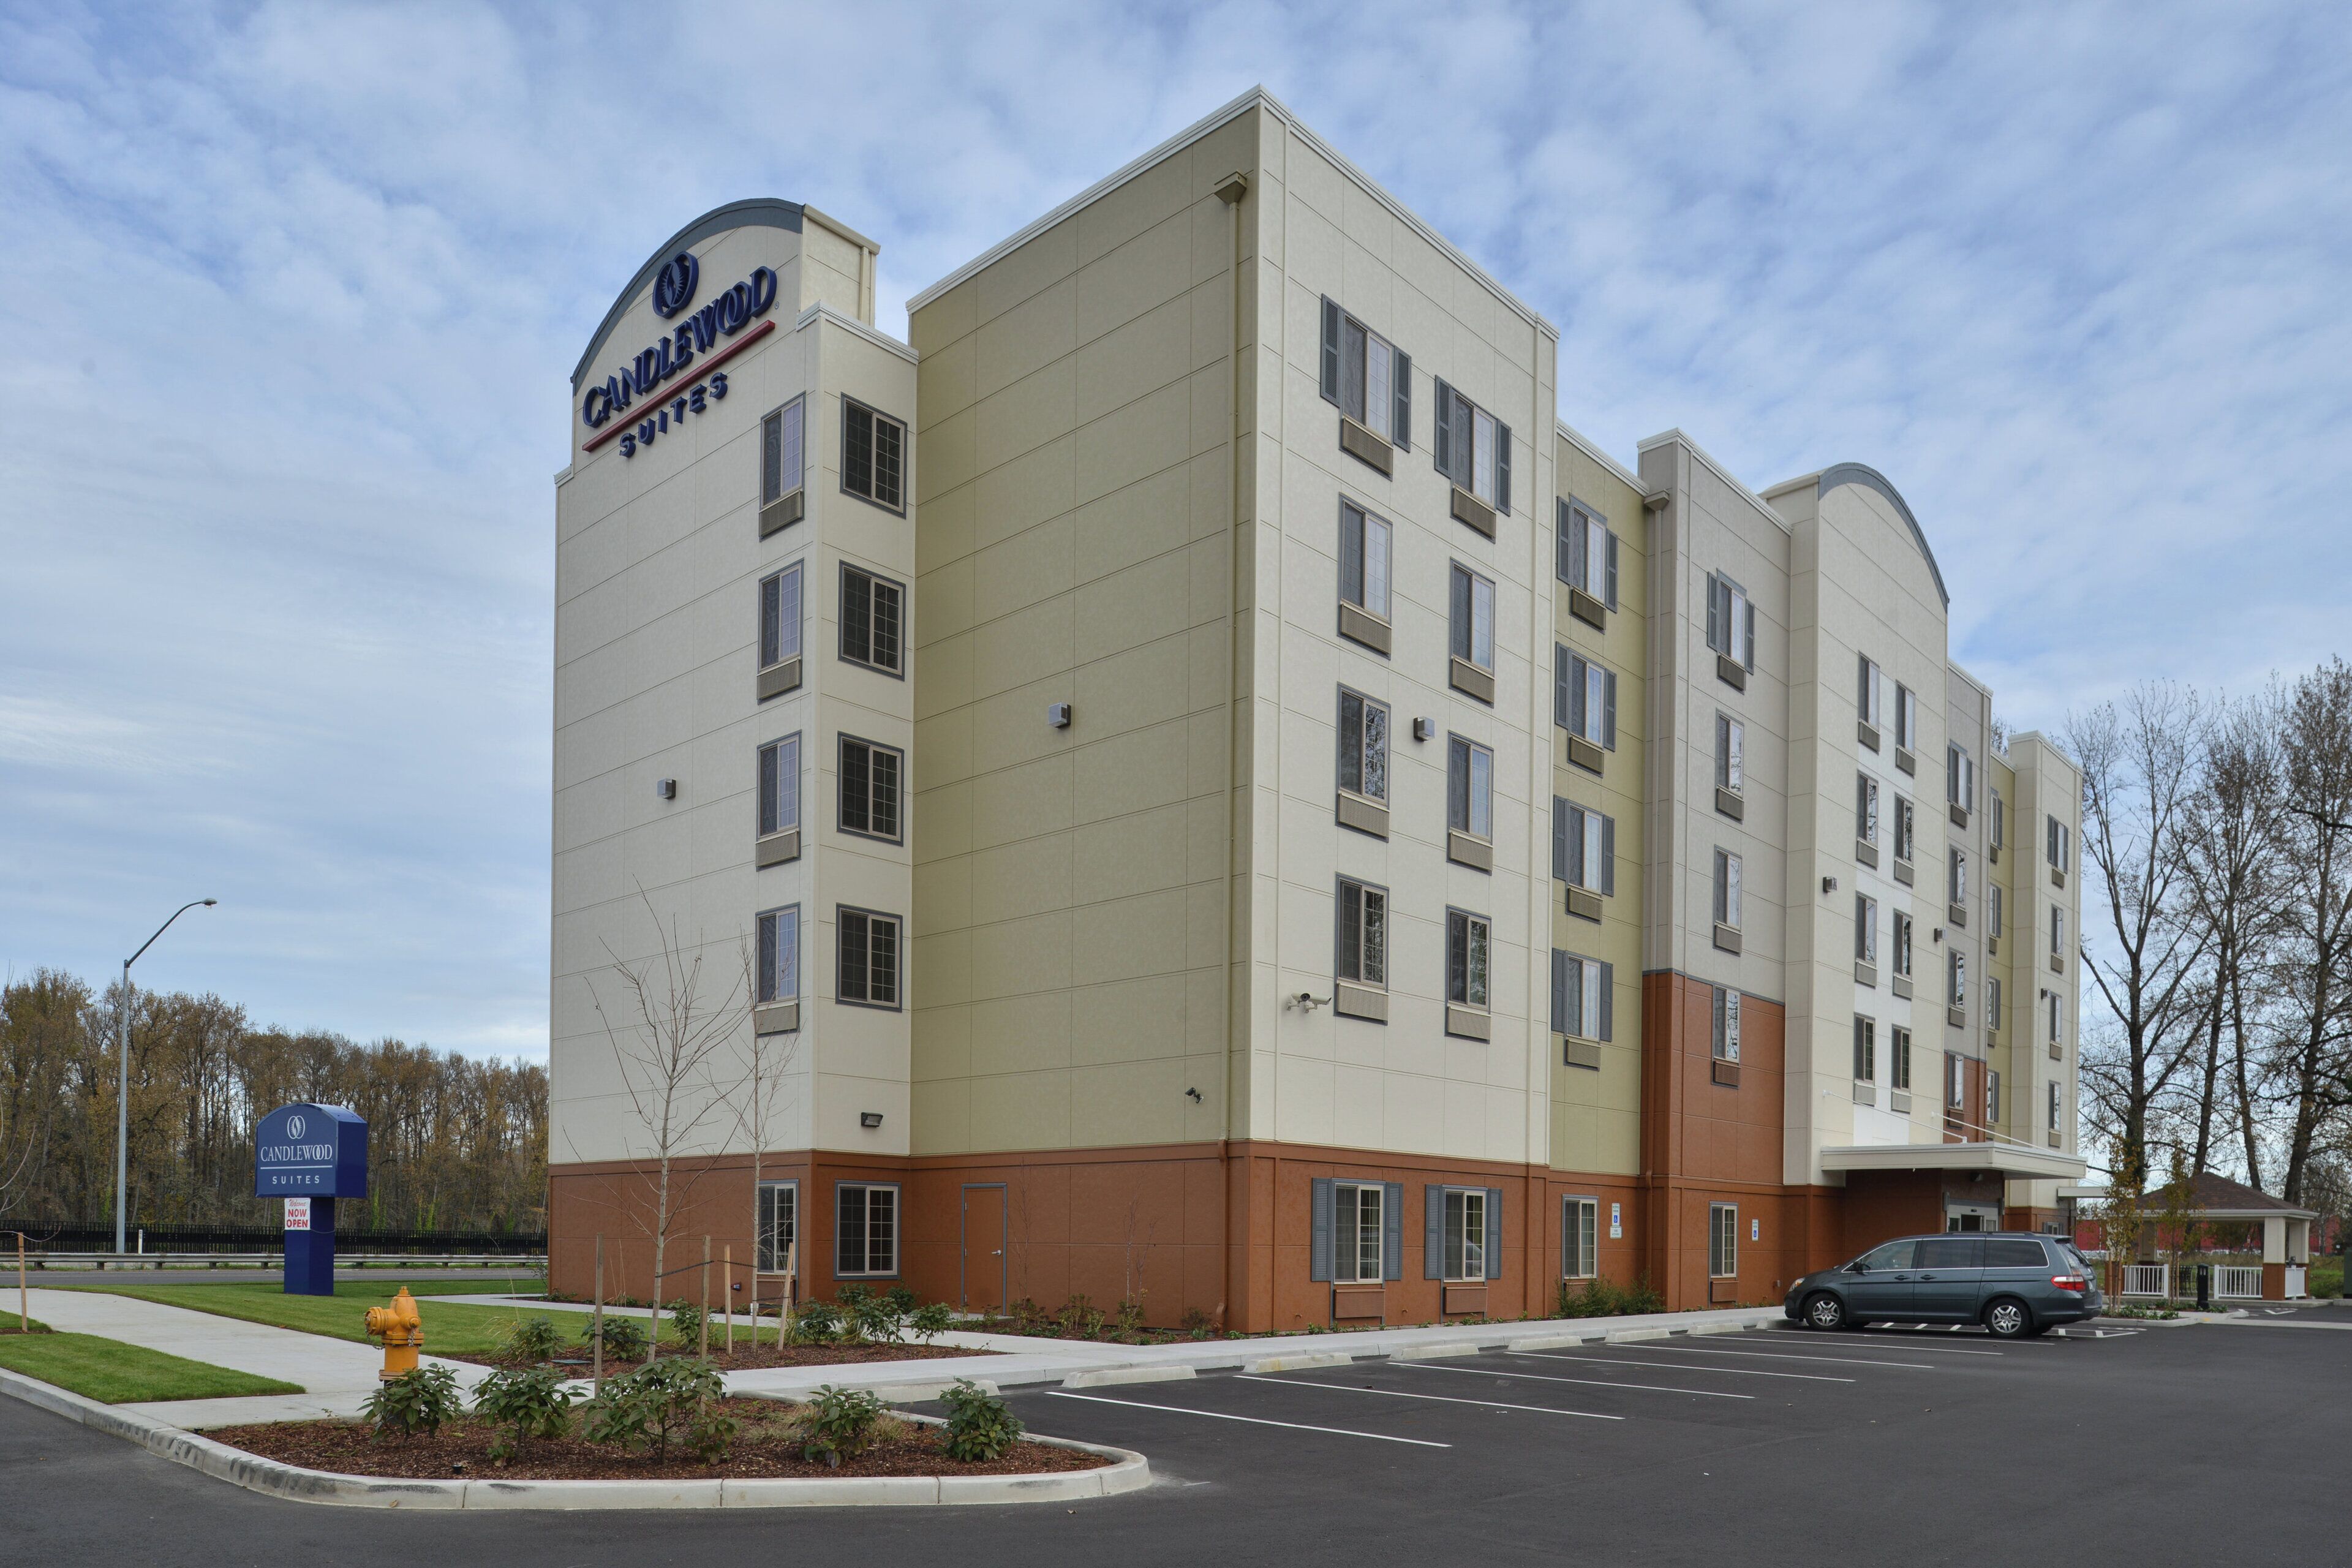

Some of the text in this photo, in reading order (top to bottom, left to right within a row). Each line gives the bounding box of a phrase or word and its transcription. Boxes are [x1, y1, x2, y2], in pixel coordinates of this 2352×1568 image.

[583, 266, 777, 428] CANDLEWOOD
[619, 372, 728, 458] SUITES
[260, 1144, 333, 1162] CANDLEWOOD
[272, 1175, 320, 1184] SUITES
[288, 1208, 307, 1217] NOW
[286, 1219, 308, 1227] OPEN
